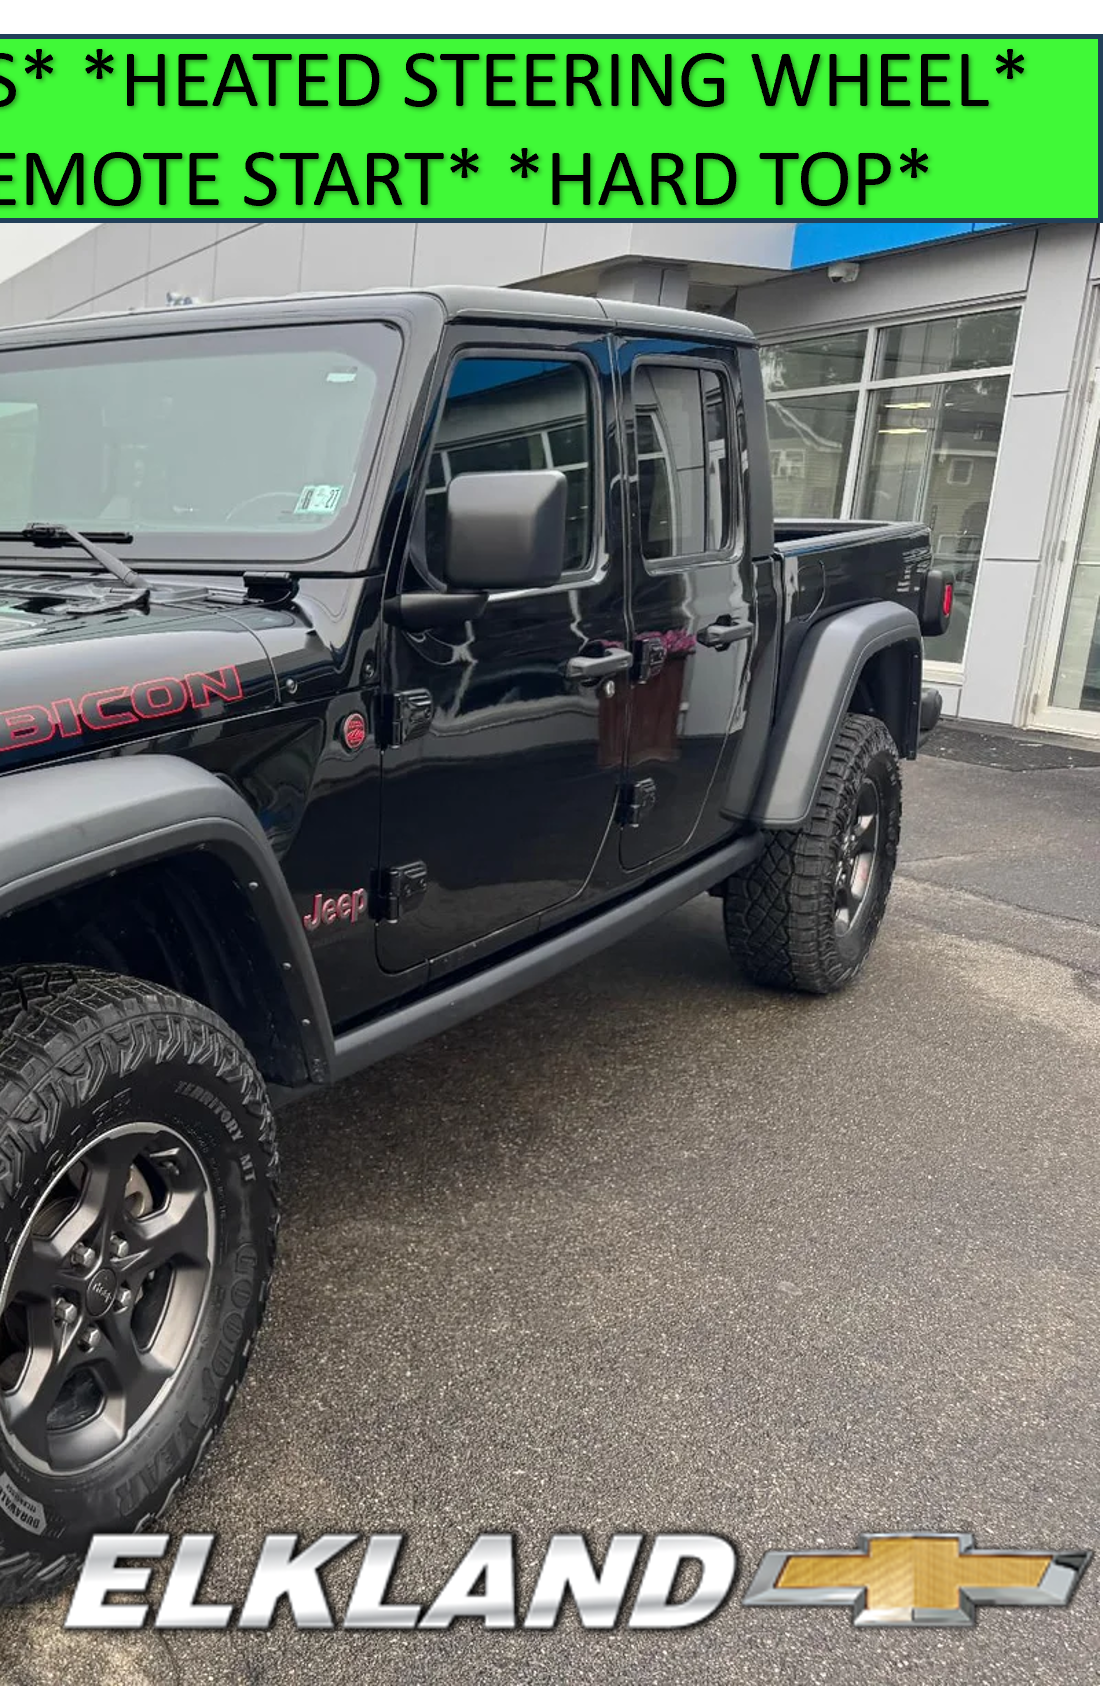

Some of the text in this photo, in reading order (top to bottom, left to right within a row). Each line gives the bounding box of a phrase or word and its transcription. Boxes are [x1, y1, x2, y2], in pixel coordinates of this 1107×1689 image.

[303, 888, 368, 931] Jeep
[174, 1080, 245, 1141] TERRITORY
[239, 1153, 257, 1181] MT
